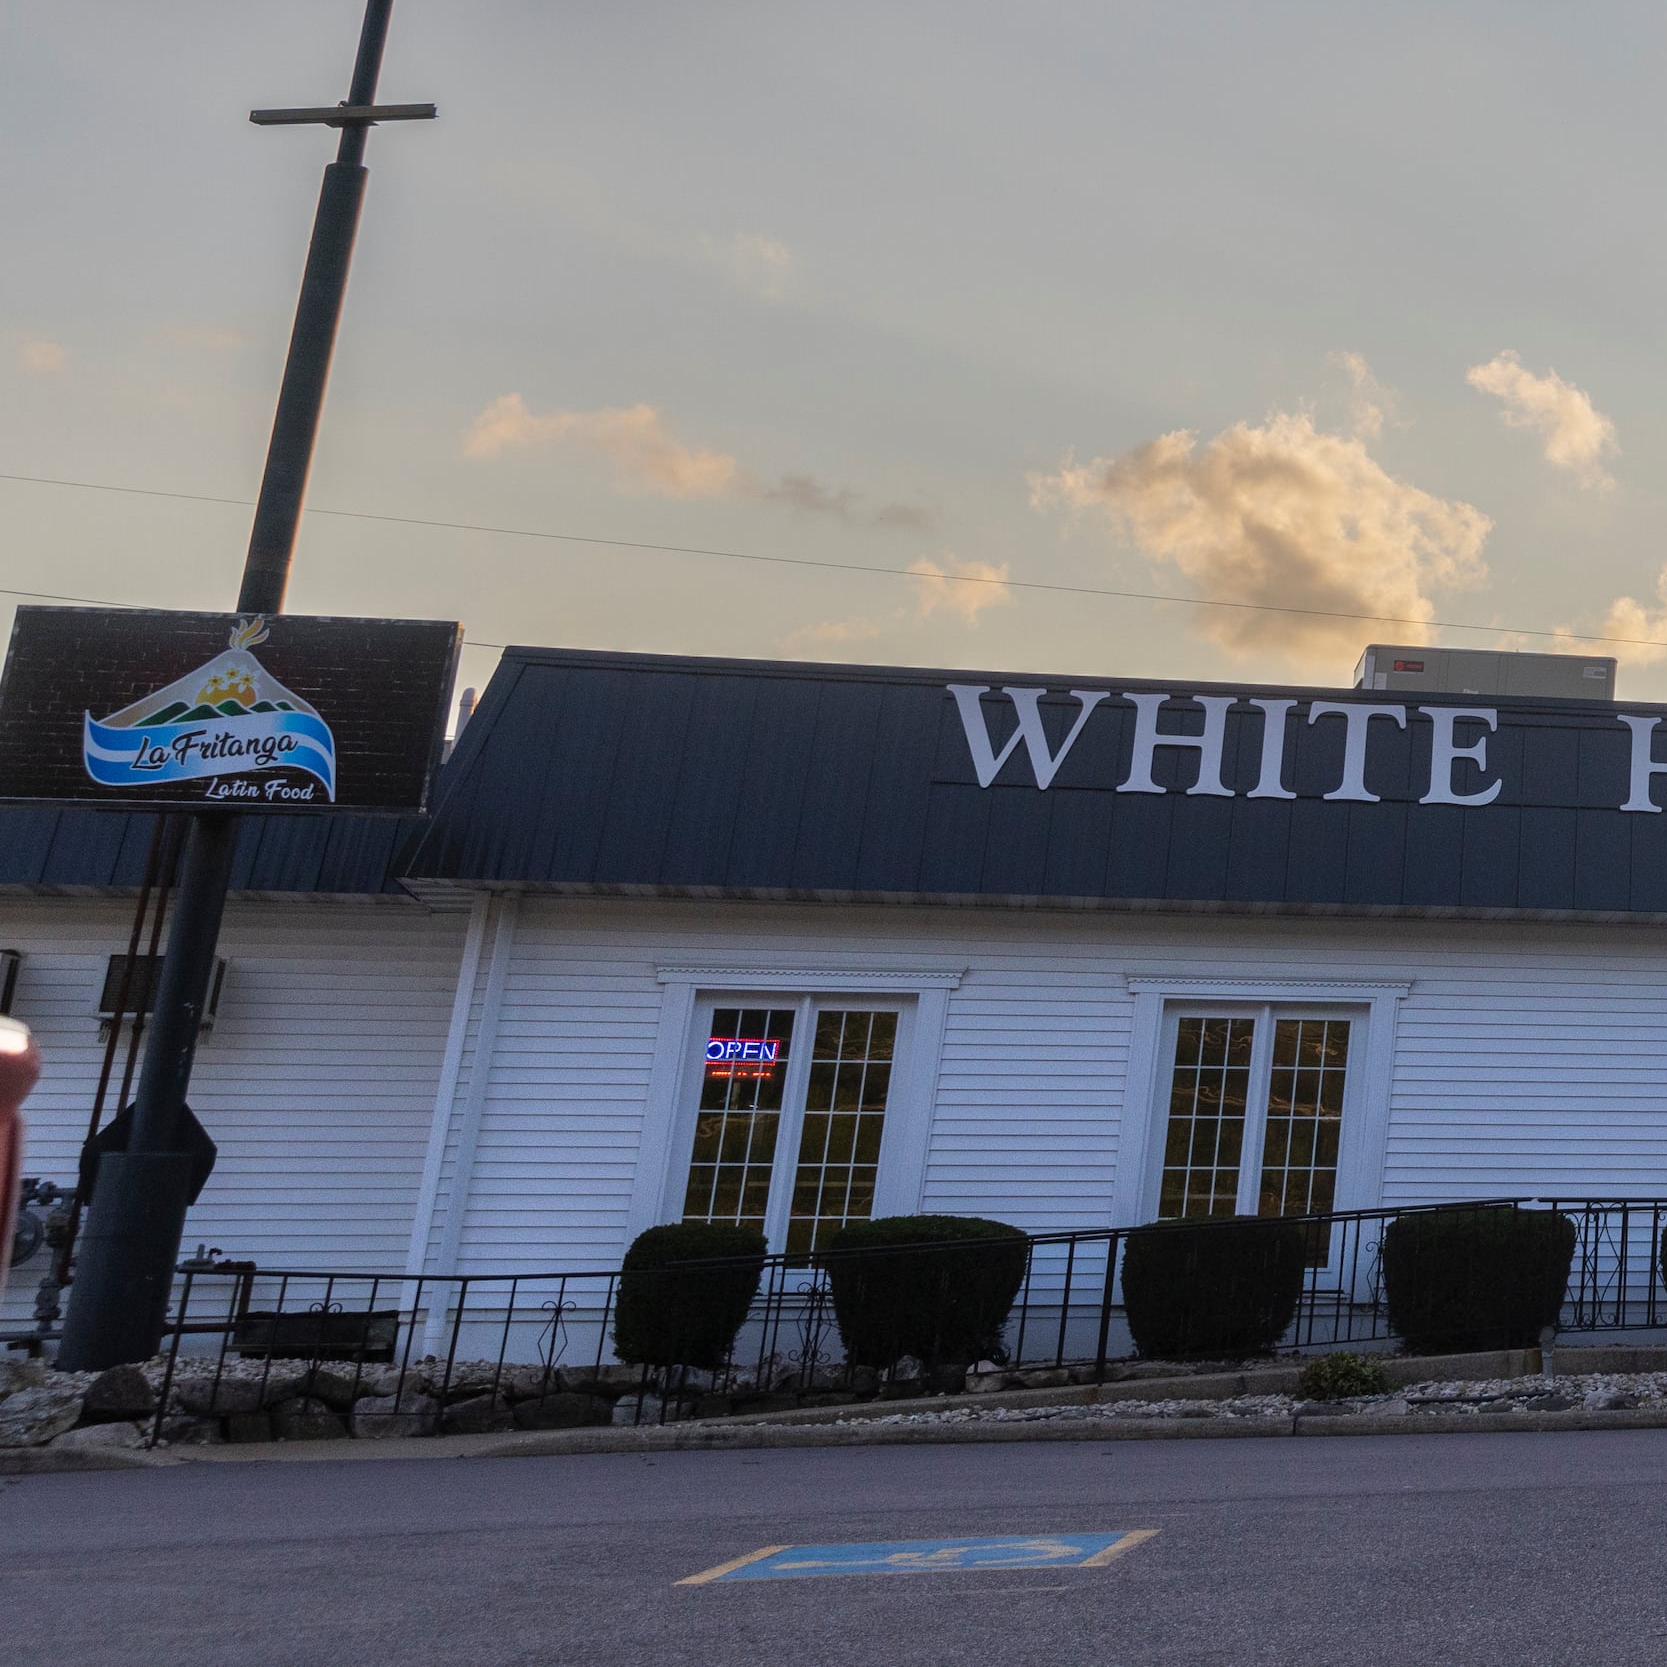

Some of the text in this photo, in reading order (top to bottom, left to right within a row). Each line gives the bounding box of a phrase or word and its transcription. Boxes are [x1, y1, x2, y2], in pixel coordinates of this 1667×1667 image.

[131, 729, 299, 770] La Fritanga
[945, 684, 1504, 808] WHITE
[205, 777, 315, 801] Latin Food
[706, 1040, 777, 1061] OPEN
